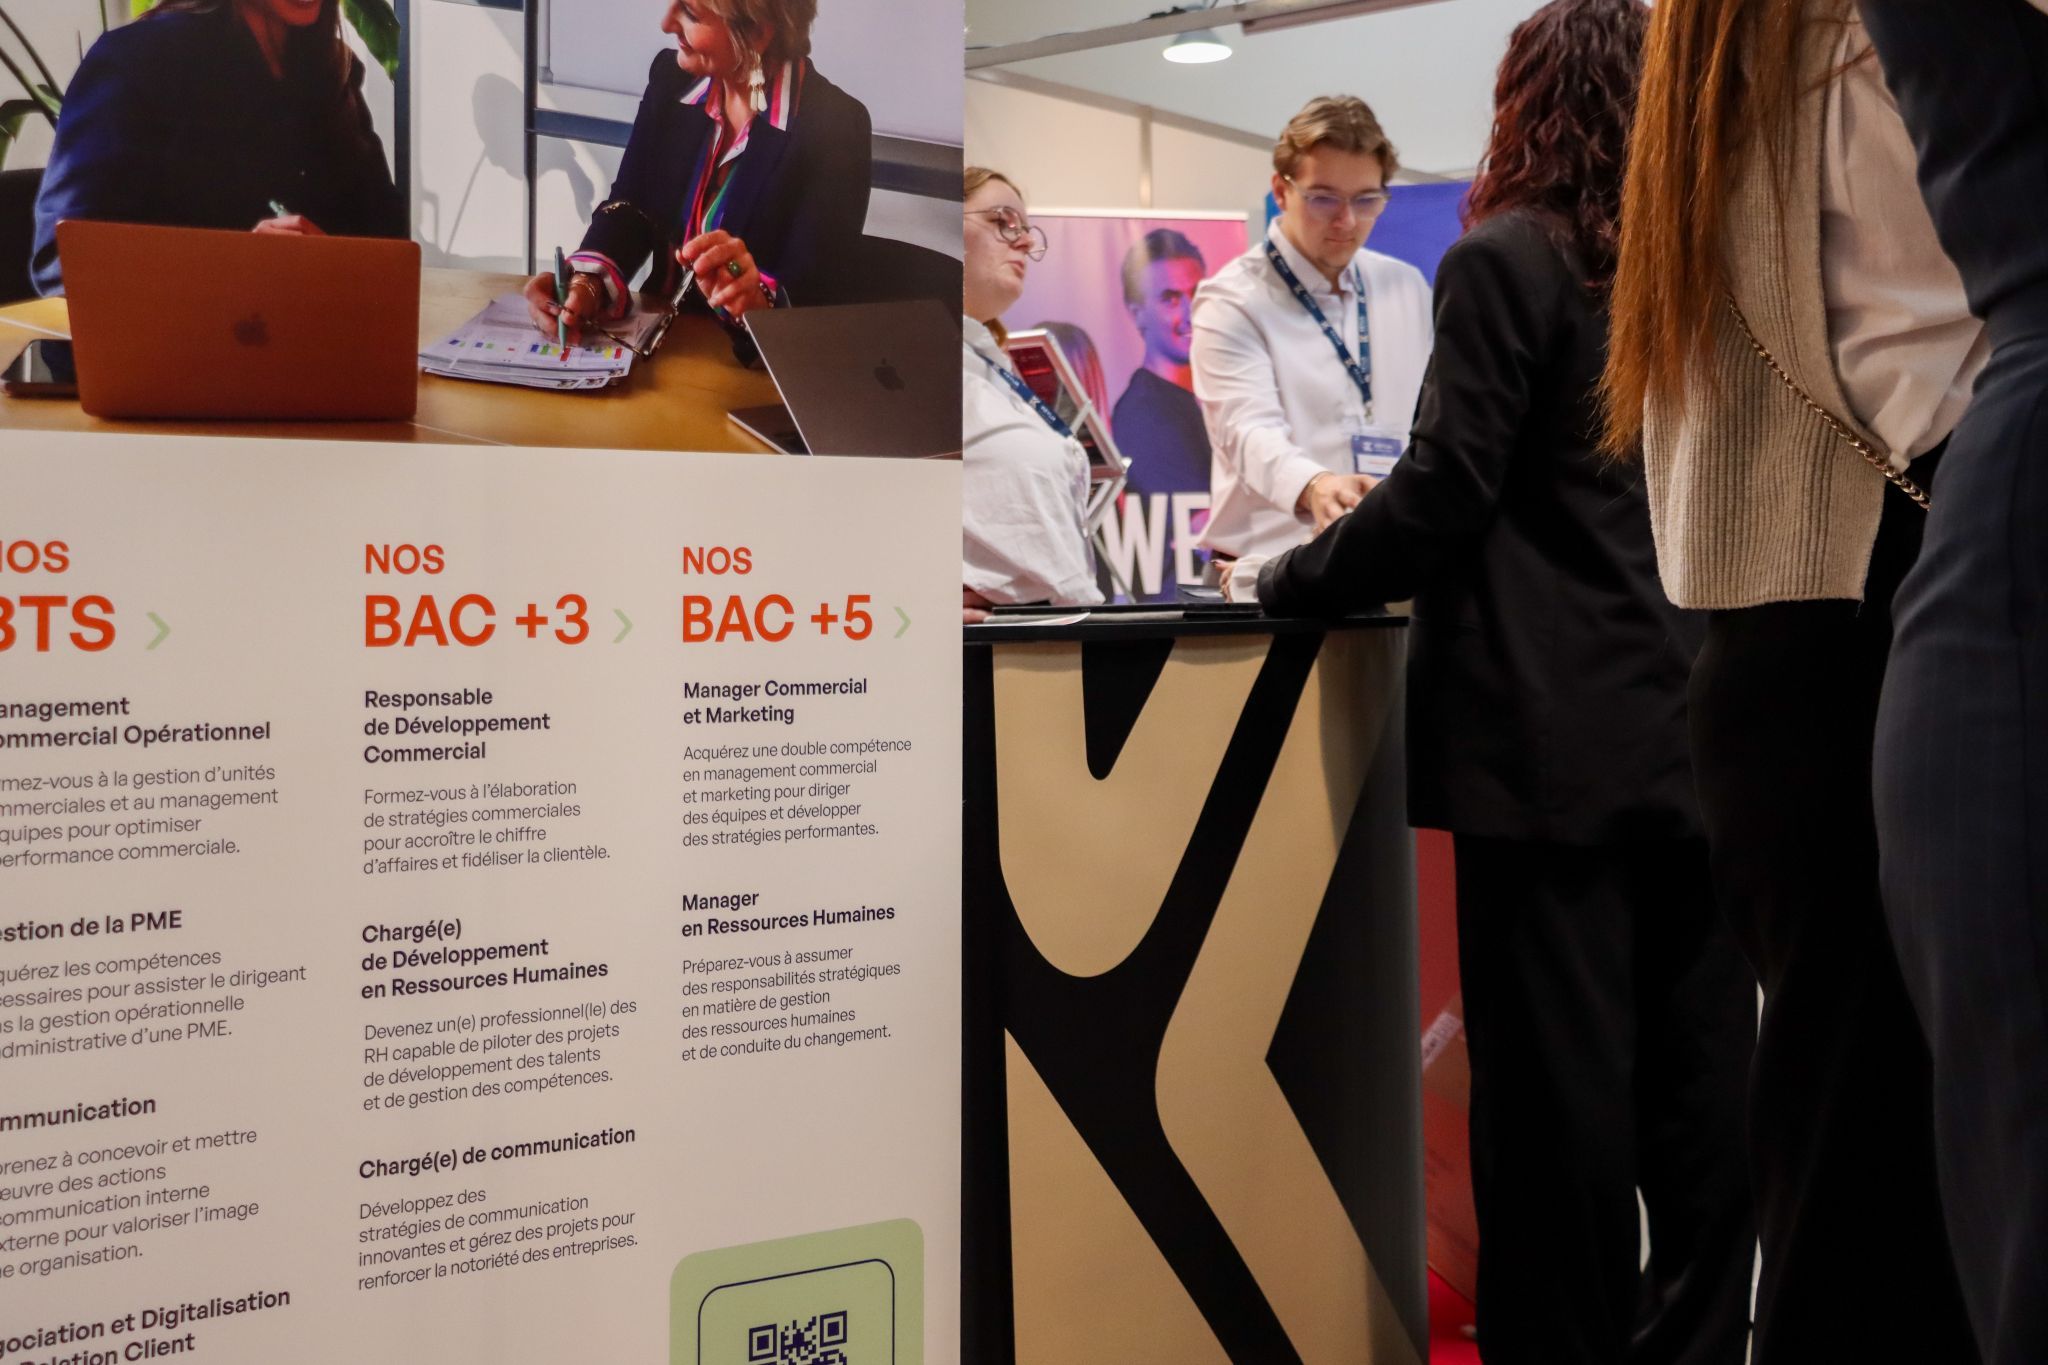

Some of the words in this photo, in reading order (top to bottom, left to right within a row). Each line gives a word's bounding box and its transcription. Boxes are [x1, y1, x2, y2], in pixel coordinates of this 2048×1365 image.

[0, 540, 70, 574] OS
[365, 544, 445, 575] NOS
[683, 546, 752, 575] NOS
[365, 593, 496, 647] BAC
[515, 593, 590, 645] +3
[682, 594, 795, 643] BAC
[811, 594, 873, 641] +5
[365, 688, 493, 711] Responsable
[684, 682, 761, 701] Manager
[765, 678, 867, 696] Commercial
[364, 718, 389, 736] de
[395, 713, 550, 736] Développement
[684, 708, 702, 724] et
[706, 705, 794, 725] Marketing
[124, 721, 270, 748] Opérationnel
[364, 741, 485, 763] Commercial
[683, 745, 749, 763] Acquérez
[752, 746, 778, 758] une
[781, 741, 827, 756] double
[830, 738, 911, 756] compétence
[132, 769, 200, 790] gestion
[683, 770, 700, 782] en
[704, 763, 796, 783] management
[799, 759, 876, 776] commercial
[110, 795, 129, 812] et
[133, 797, 154, 810] au
[160, 788, 279, 810] management
[365, 788, 466, 805] Formez-vous
[682, 789, 698, 804] et
[701, 786, 771, 803] marketing
[774, 785, 806, 802] pour
[808, 782, 851, 799] diriger
[363, 812, 384, 828] de
[389, 808, 468, 828] stratégies
[472, 802, 581, 822] commerciales
[683, 810, 708, 825] des
[711, 808, 766, 826] équipes
[769, 806, 784, 820] et
[787, 803, 861, 820] développer
[67, 824, 111, 842] pour
[113, 817, 202, 838] optimiser
[364, 837, 402, 855] pour
[405, 830, 475, 848] accroître
[478, 829, 493, 844] le
[495, 826, 546, 843] chiffre
[682, 832, 708, 847] des
[712, 828, 781, 846] stratégies
[784, 823, 878, 844] performantes.
[118, 838, 240, 860] commerciale.
[441, 854, 458, 869] et
[461, 850, 524, 868] fidéliser
[528, 849, 539, 863] la
[543, 845, 610, 862] clientèle.
[683, 893, 759, 911] Manager
[70, 917, 99, 936] de
[131, 910, 182, 932] PME
[362, 918, 461, 943] Chargé(e)
[682, 923, 703, 937] en
[708, 915, 808, 935] Ressources
[813, 906, 895, 926] Humaines
[63, 961, 91, 977] les
[95, 952, 221, 974] compétences
[362, 953, 387, 971] de
[393, 939, 549, 968] Développement
[683, 954, 782, 975] Préparez-vous
[795, 948, 853, 964] assumer
[87, 984, 131, 1004] pour
[134, 976, 206, 995] assister
[210, 972, 225, 988] le
[229, 966, 307, 988] dirigeant
[361, 984, 386, 999] en
[392, 972, 508, 996] Ressources
[513, 962, 608, 984] Humaines
[682, 981, 707, 996] des
[711, 969, 815, 994] responsabilités
[819, 964, 900, 982] stratégiques
[39, 1009, 110, 1034] gestion
[114, 995, 244, 1024] opérationnelle
[682, 1005, 699, 1018] en
[703, 998, 757, 1015] matière
[759, 995, 777, 1009] de
[779, 991, 830, 1011] gestion
[186, 1020, 232, 1039] PME.
[365, 1022, 433, 1040] Devenez
[437, 1014, 476, 1034] un(e)
[480, 1001, 606, 1031] professionnel(le)
[609, 1000, 637, 1015] des
[682, 1025, 708, 1039] des
[711, 1017, 787, 1036] ressources
[791, 1010, 855, 1027] humaines
[364, 1046, 388, 1064] RH
[392, 1040, 456, 1063] capable
[459, 1037, 480, 1054] de
[482, 1034, 532, 1055] piloter
[535, 1029, 564, 1045] des
[567, 1024, 620, 1045] projets
[682, 1046, 697, 1061] et
[700, 1044, 717, 1059] de
[720, 1037, 781, 1056] conduite
[784, 1034, 801, 1049] du
[804, 1025, 891, 1047] changement.
[364, 1072, 384, 1087] de
[388, 1056, 513, 1084] développement
[516, 1053, 544, 1069] des
[548, 1048, 600, 1066] talents
[363, 1095, 380, 1111] et
[384, 1092, 405, 1108] de
[408, 1083, 467, 1109] gestion
[472, 1082, 500, 1097] des
[503, 1070, 613, 1093] compétences.
[77, 1139, 168, 1165] concevoir
[171, 1136, 191, 1152] et
[195, 1130, 257, 1150] mettre
[359, 1149, 457, 1179] Chargé(e)
[463, 1146, 486, 1165] de
[491, 1128, 635, 1160] communication
[57, 1176, 93, 1193] des
[97, 1167, 166, 1187] actions
[146, 1185, 210, 1206] interne
[360, 1195, 454, 1219] Développez
[457, 1189, 486, 1205] des
[63, 1224, 109, 1247] pour
[112, 1212, 191, 1235] valoriser
[359, 1219, 441, 1243] stratégies
[445, 1213, 465, 1230] de
[468, 1197, 588, 1226] communication
[359, 1242, 446, 1267] innovantes
[449, 1236, 466, 1252] et
[469, 1232, 512, 1253] gérez
[515, 1226, 543, 1242] des
[546, 1217, 598, 1240] projets
[602, 1213, 635, 1232] pour
[18, 1245, 143, 1276] organisation.
[359, 1267, 432, 1290] renforcer
[435, 1262, 447, 1278] la
[451, 1250, 519, 1275] notoriété
[522, 1248, 550, 1263] des
[551, 1235, 638, 1258] entreprises.
[110, 1314, 135, 1334] et
[142, 1291, 290, 1329] Digitalisation
[124, 1333, 195, 1361] Client
